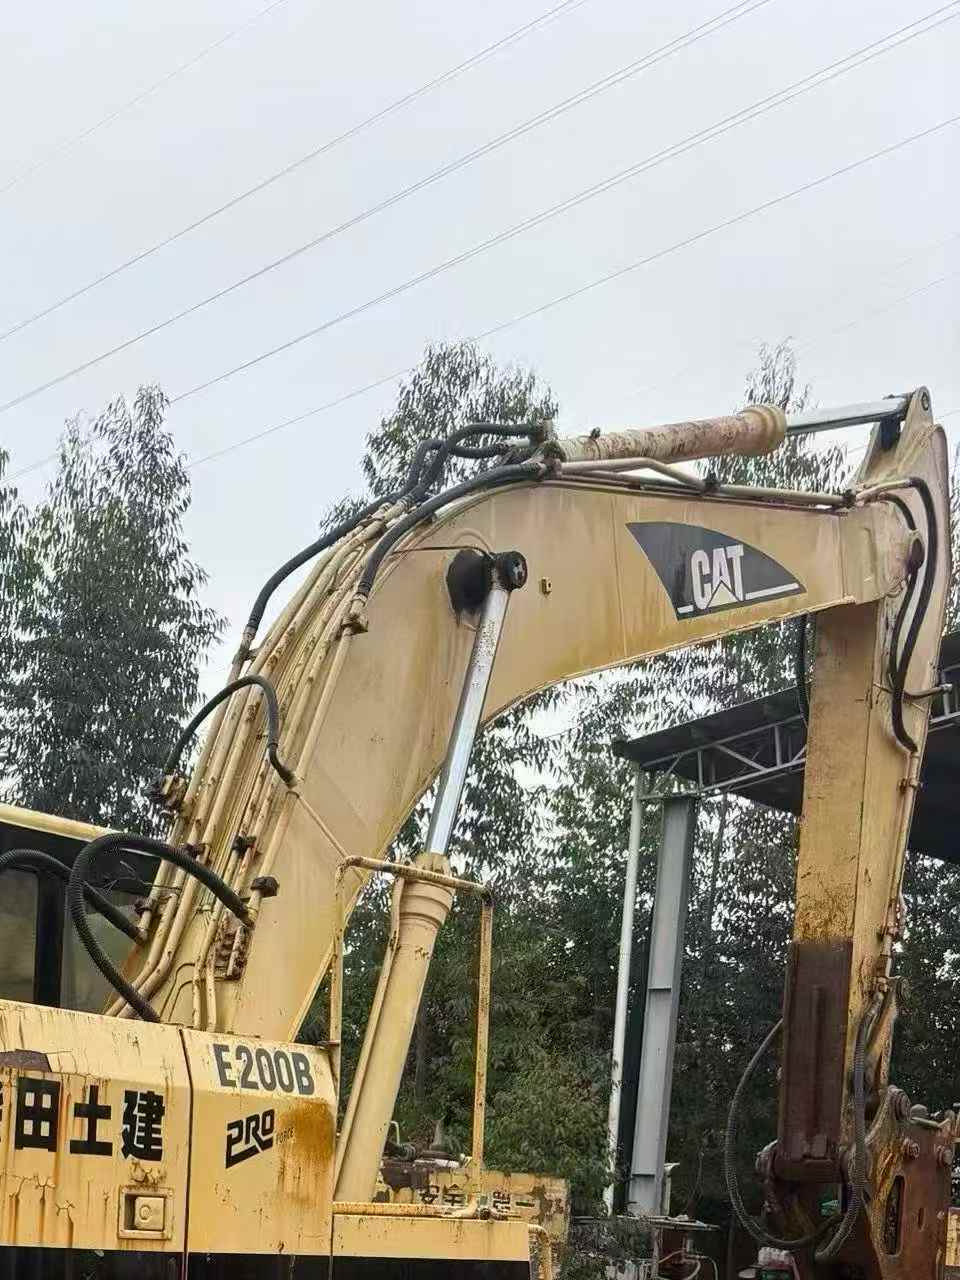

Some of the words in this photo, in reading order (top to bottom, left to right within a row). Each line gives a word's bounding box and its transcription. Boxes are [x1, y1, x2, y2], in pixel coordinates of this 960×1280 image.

[691, 544, 744, 609] CAT
[212, 1043, 315, 1095] E200B
[225, 1108, 276, 1169] PRO
